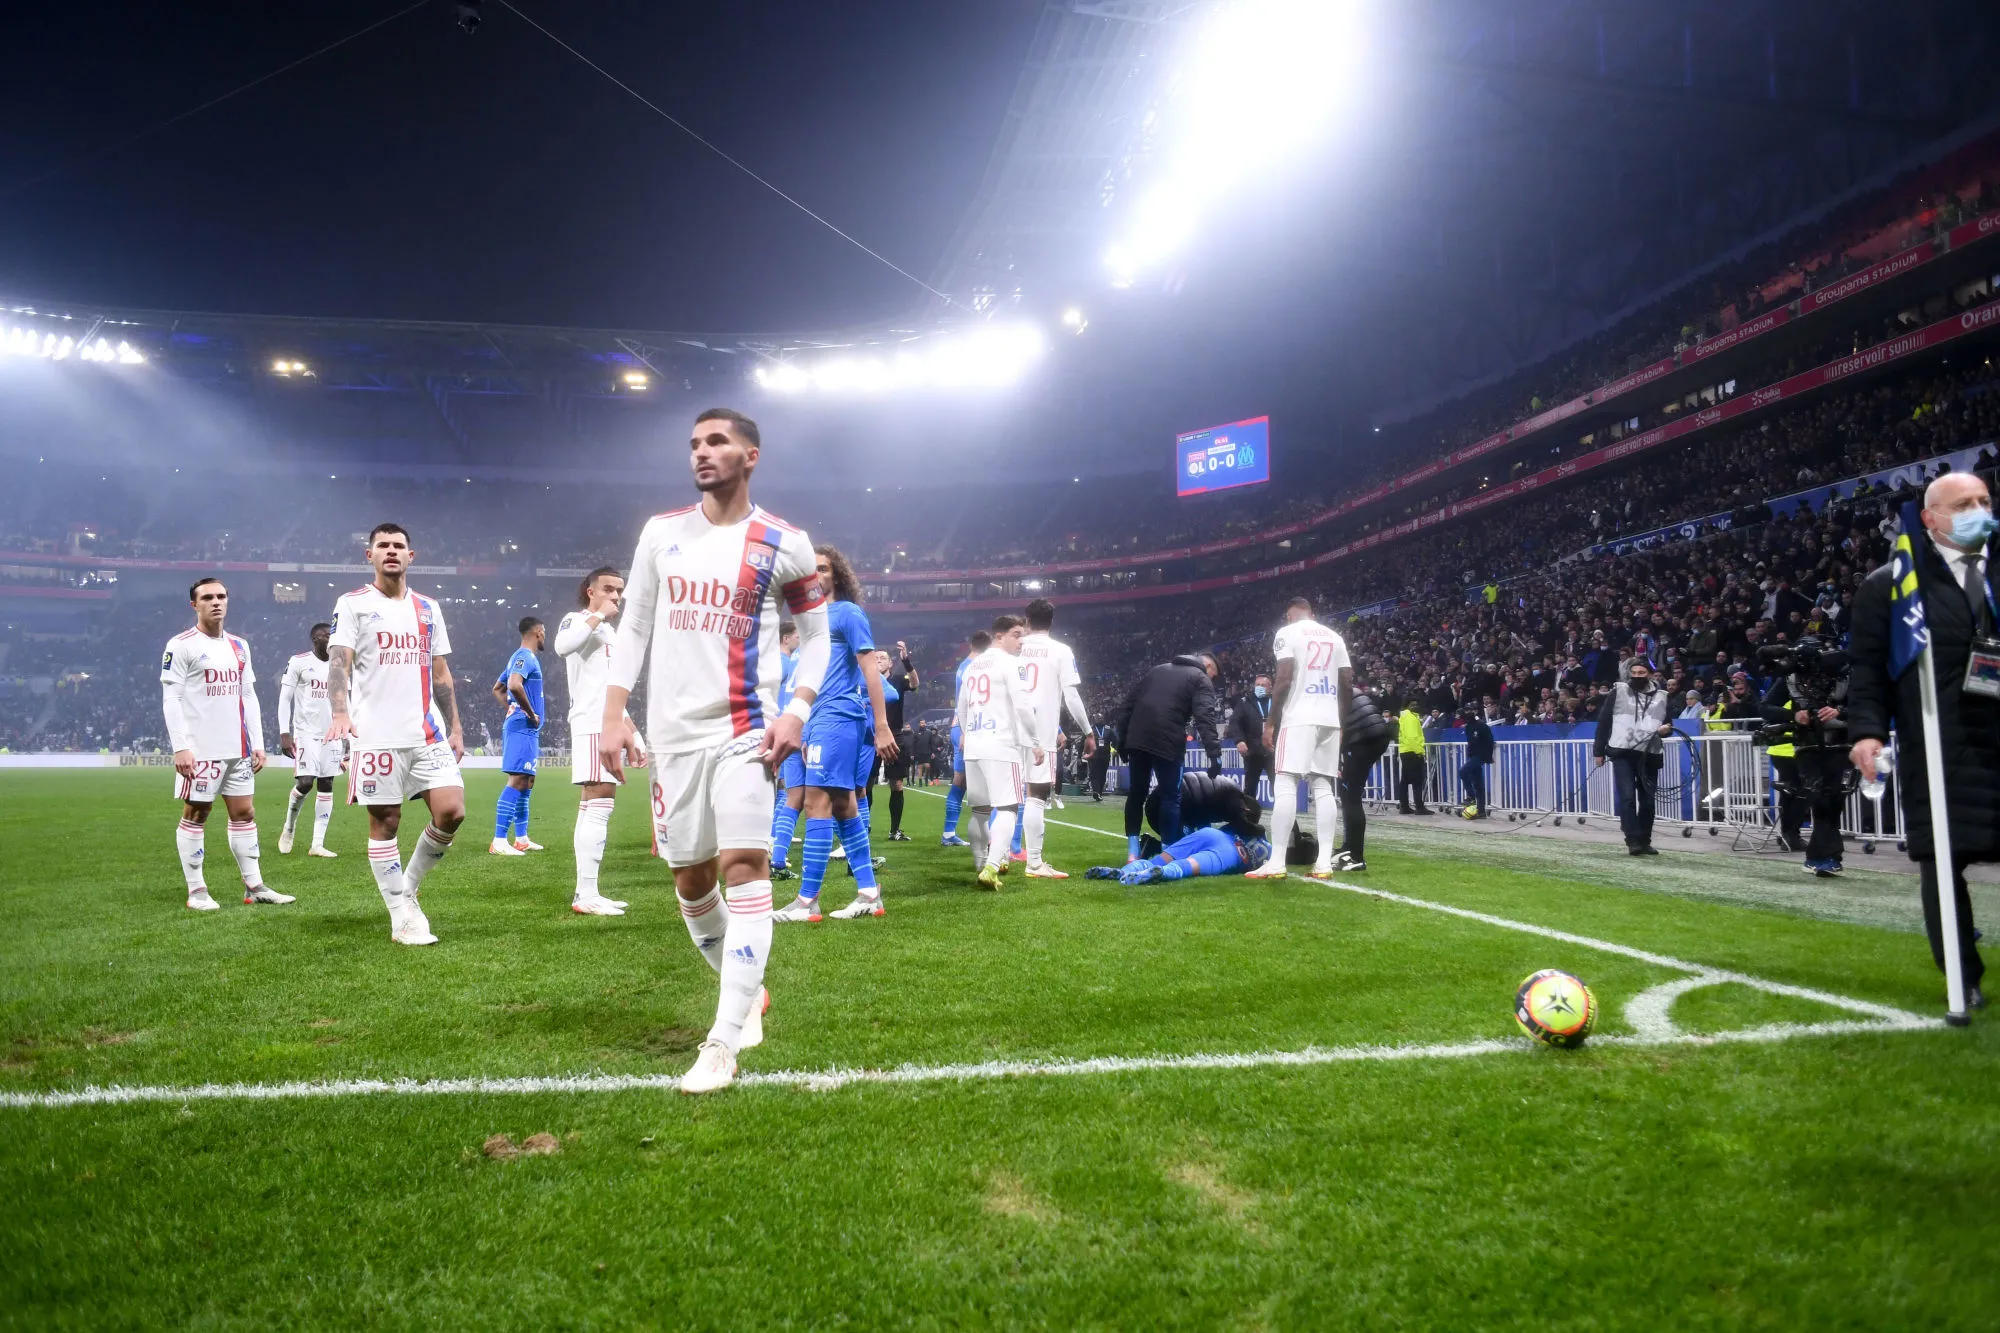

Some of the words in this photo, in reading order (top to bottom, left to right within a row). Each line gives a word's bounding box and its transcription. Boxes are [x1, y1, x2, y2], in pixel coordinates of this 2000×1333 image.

[1815, 275, 1869, 304] Groupama
[1871, 252, 1918, 280] STADIUM
[1695, 333, 1737, 357] Groupama
[1738, 317, 1774, 339] STADIUM
[1837, 346, 1886, 376] reservoir
[1602, 378, 1636, 398] Groupama
[1636, 365, 1665, 383] STADIUM
[667, 575, 763, 614] Dubai
[669, 610, 697, 630] VOUS
[700, 612, 753, 639] ATTEND
[379, 652, 402, 666] VOUS
[1307, 640, 1334, 671] 27
[206, 685, 226, 697] VOUS
[966, 673, 991, 708] 29
[119, 756, 138, 766] UN
[141, 756, 175, 766] TERR
[195, 761, 221, 780] 25
[361, 752, 393, 777] 39
[652, 782, 666, 818] 8
